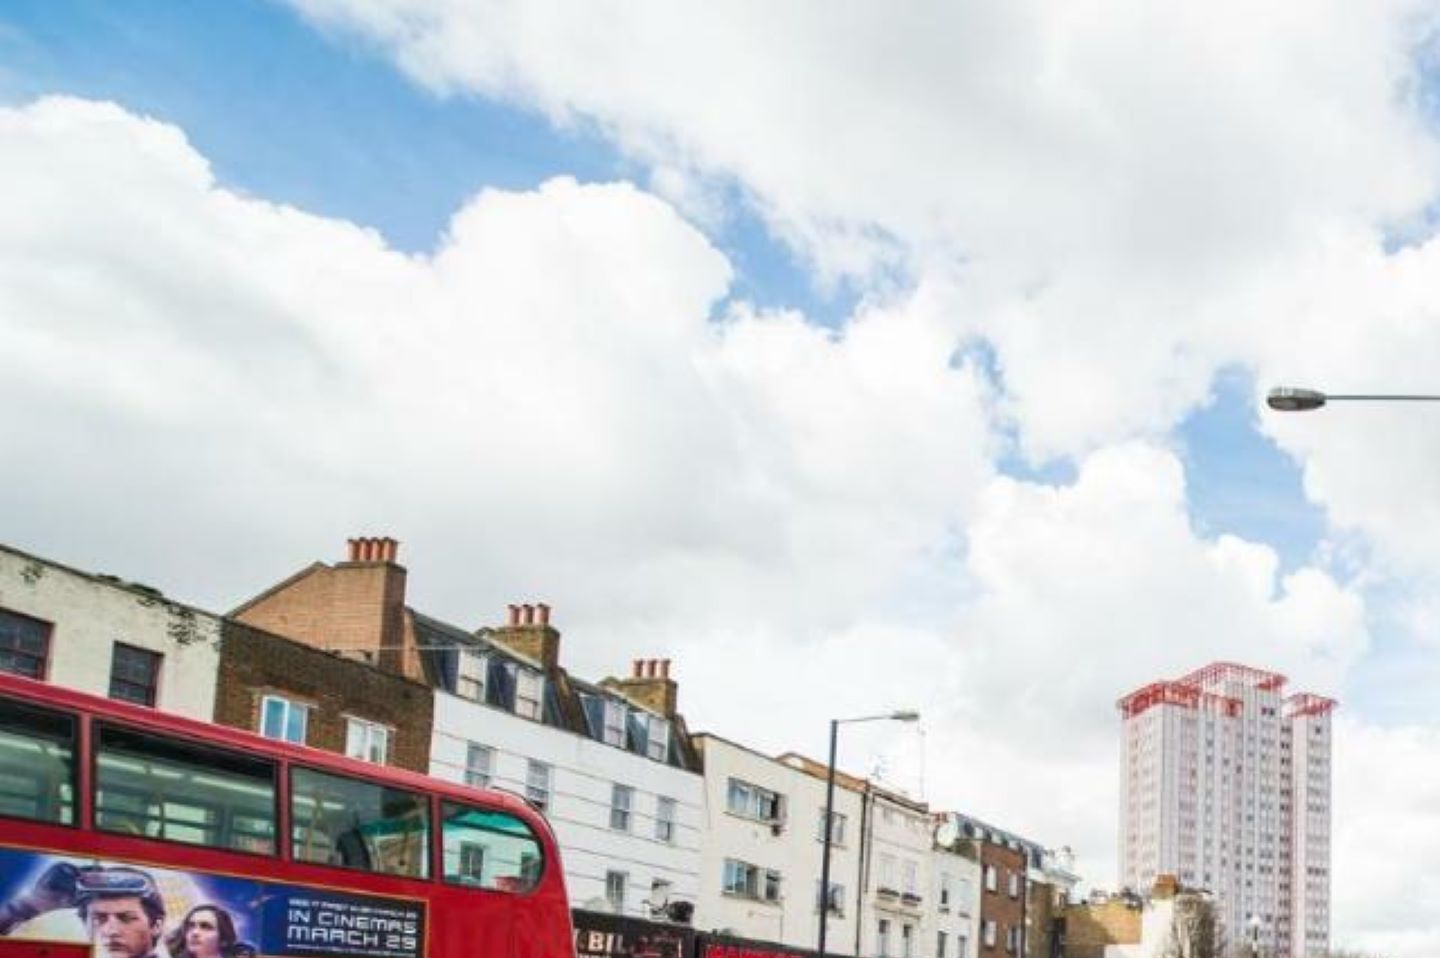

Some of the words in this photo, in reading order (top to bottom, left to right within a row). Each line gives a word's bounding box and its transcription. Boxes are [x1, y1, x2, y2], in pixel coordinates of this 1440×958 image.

[288, 909, 311, 923] IN
[317, 911, 417, 934] CINEMAS
[287, 925, 378, 947] MARCH
[386, 934, 417, 949] 29
